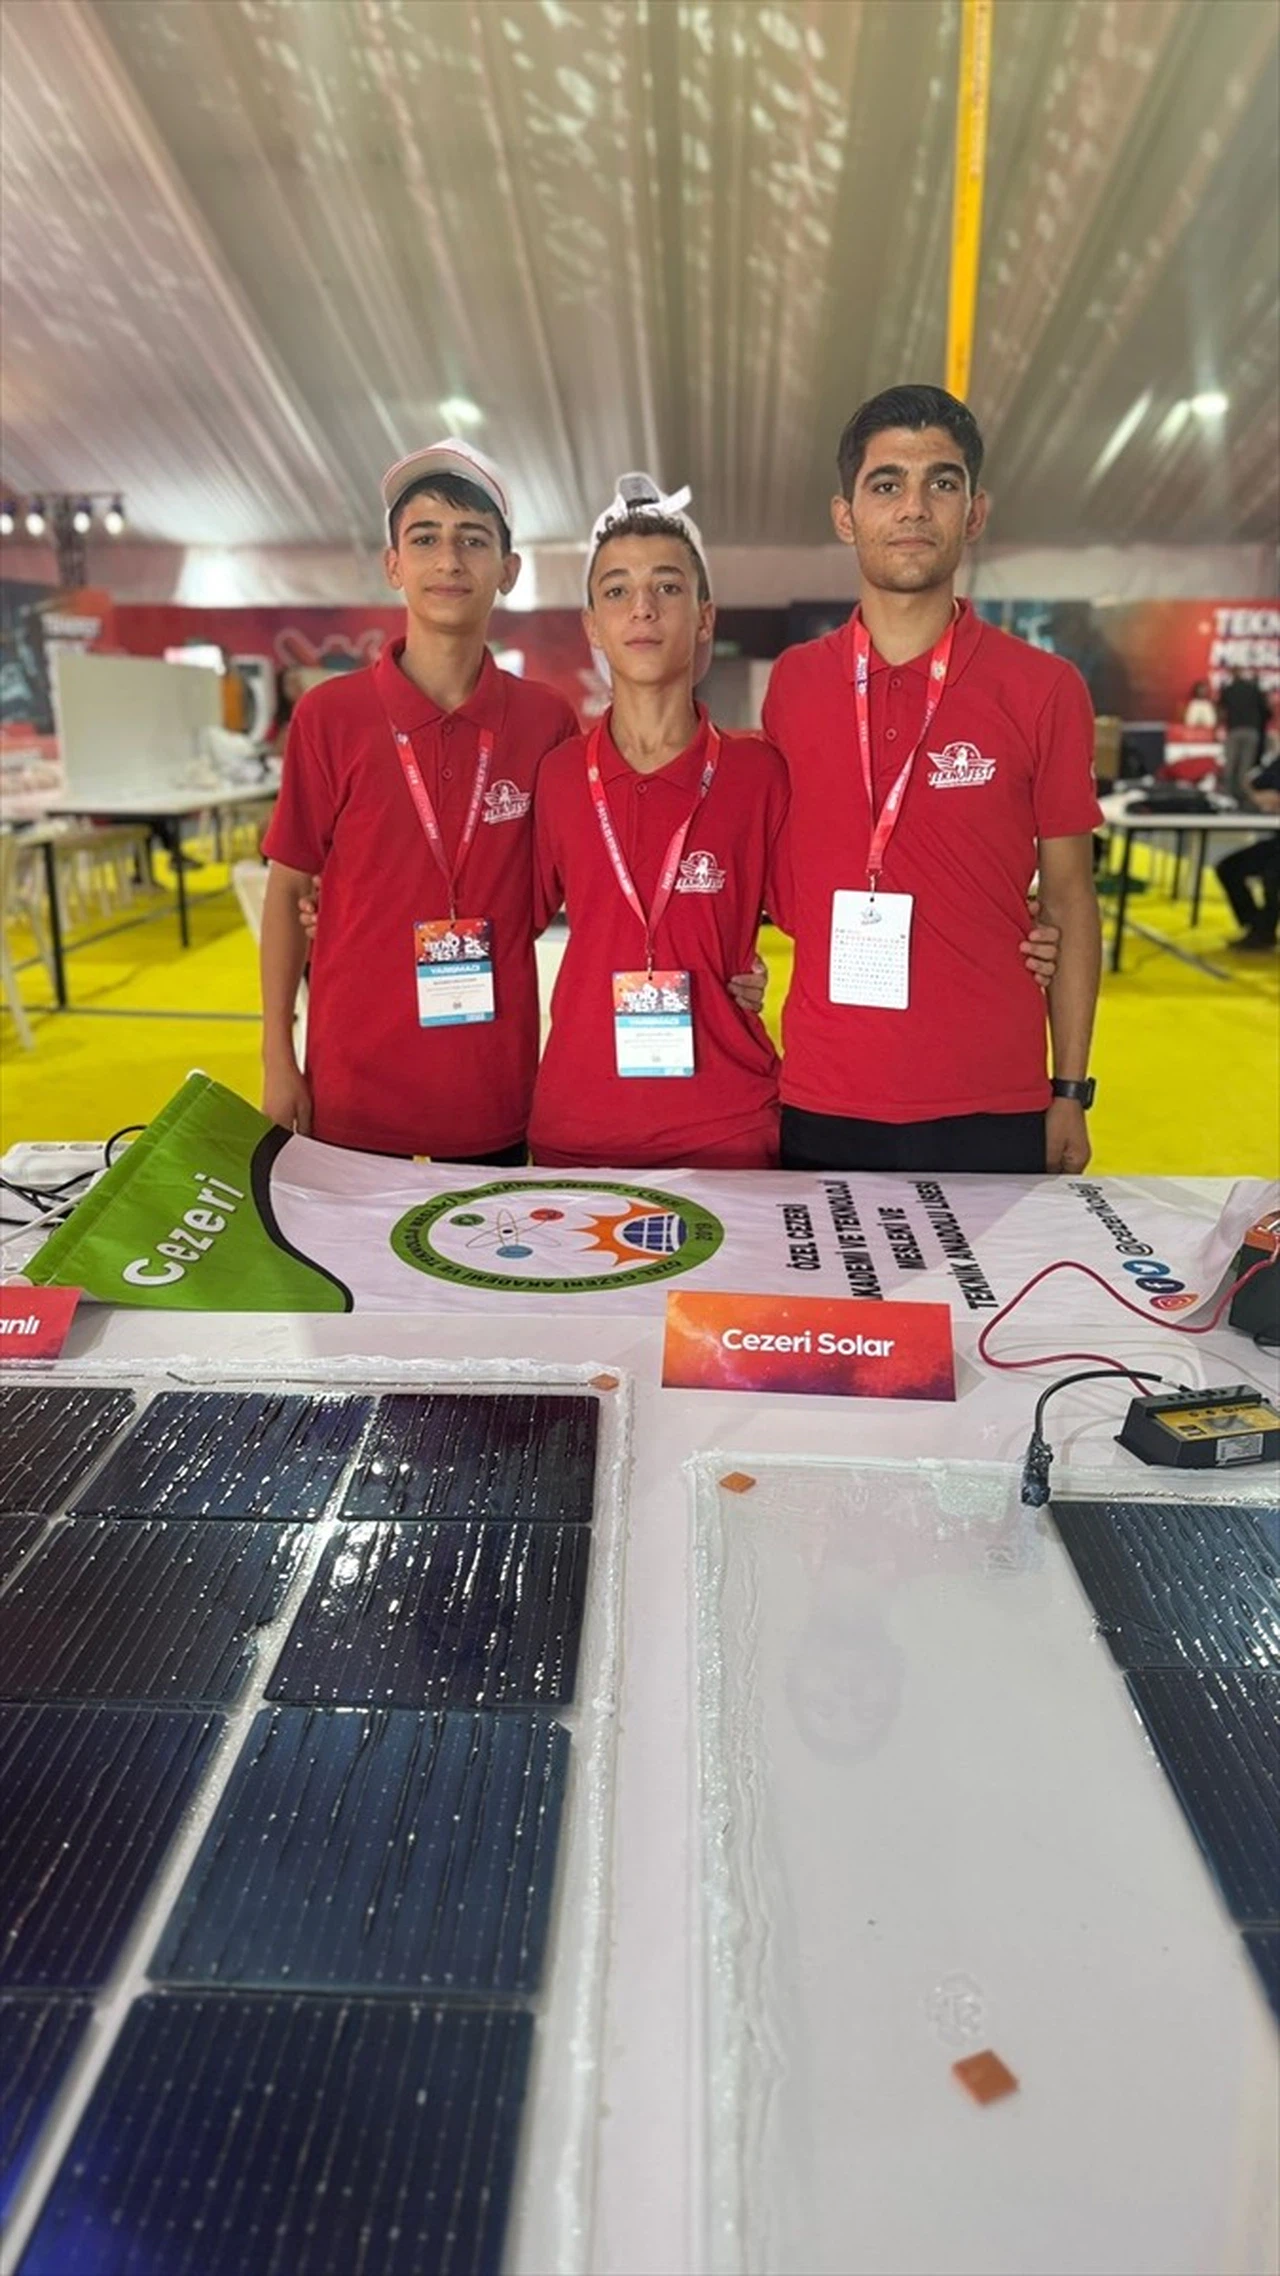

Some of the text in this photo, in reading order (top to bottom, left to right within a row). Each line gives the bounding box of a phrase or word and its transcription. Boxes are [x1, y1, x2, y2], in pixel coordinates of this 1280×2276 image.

[122, 1172, 245, 1286] Cezeri
[775, 1203, 821, 1271] ÖZEL CEZERİ
[817, 1179, 862, 1232] TEKNOLOJİ
[838, 1234, 867, 1249] VE
[877, 1207, 927, 1270] MESLEKİ VE
[908, 1180, 999, 1310] TEKNİK ANADOLU LİSESİ
[722, 1329, 895, 1357] Cezeri Solar
